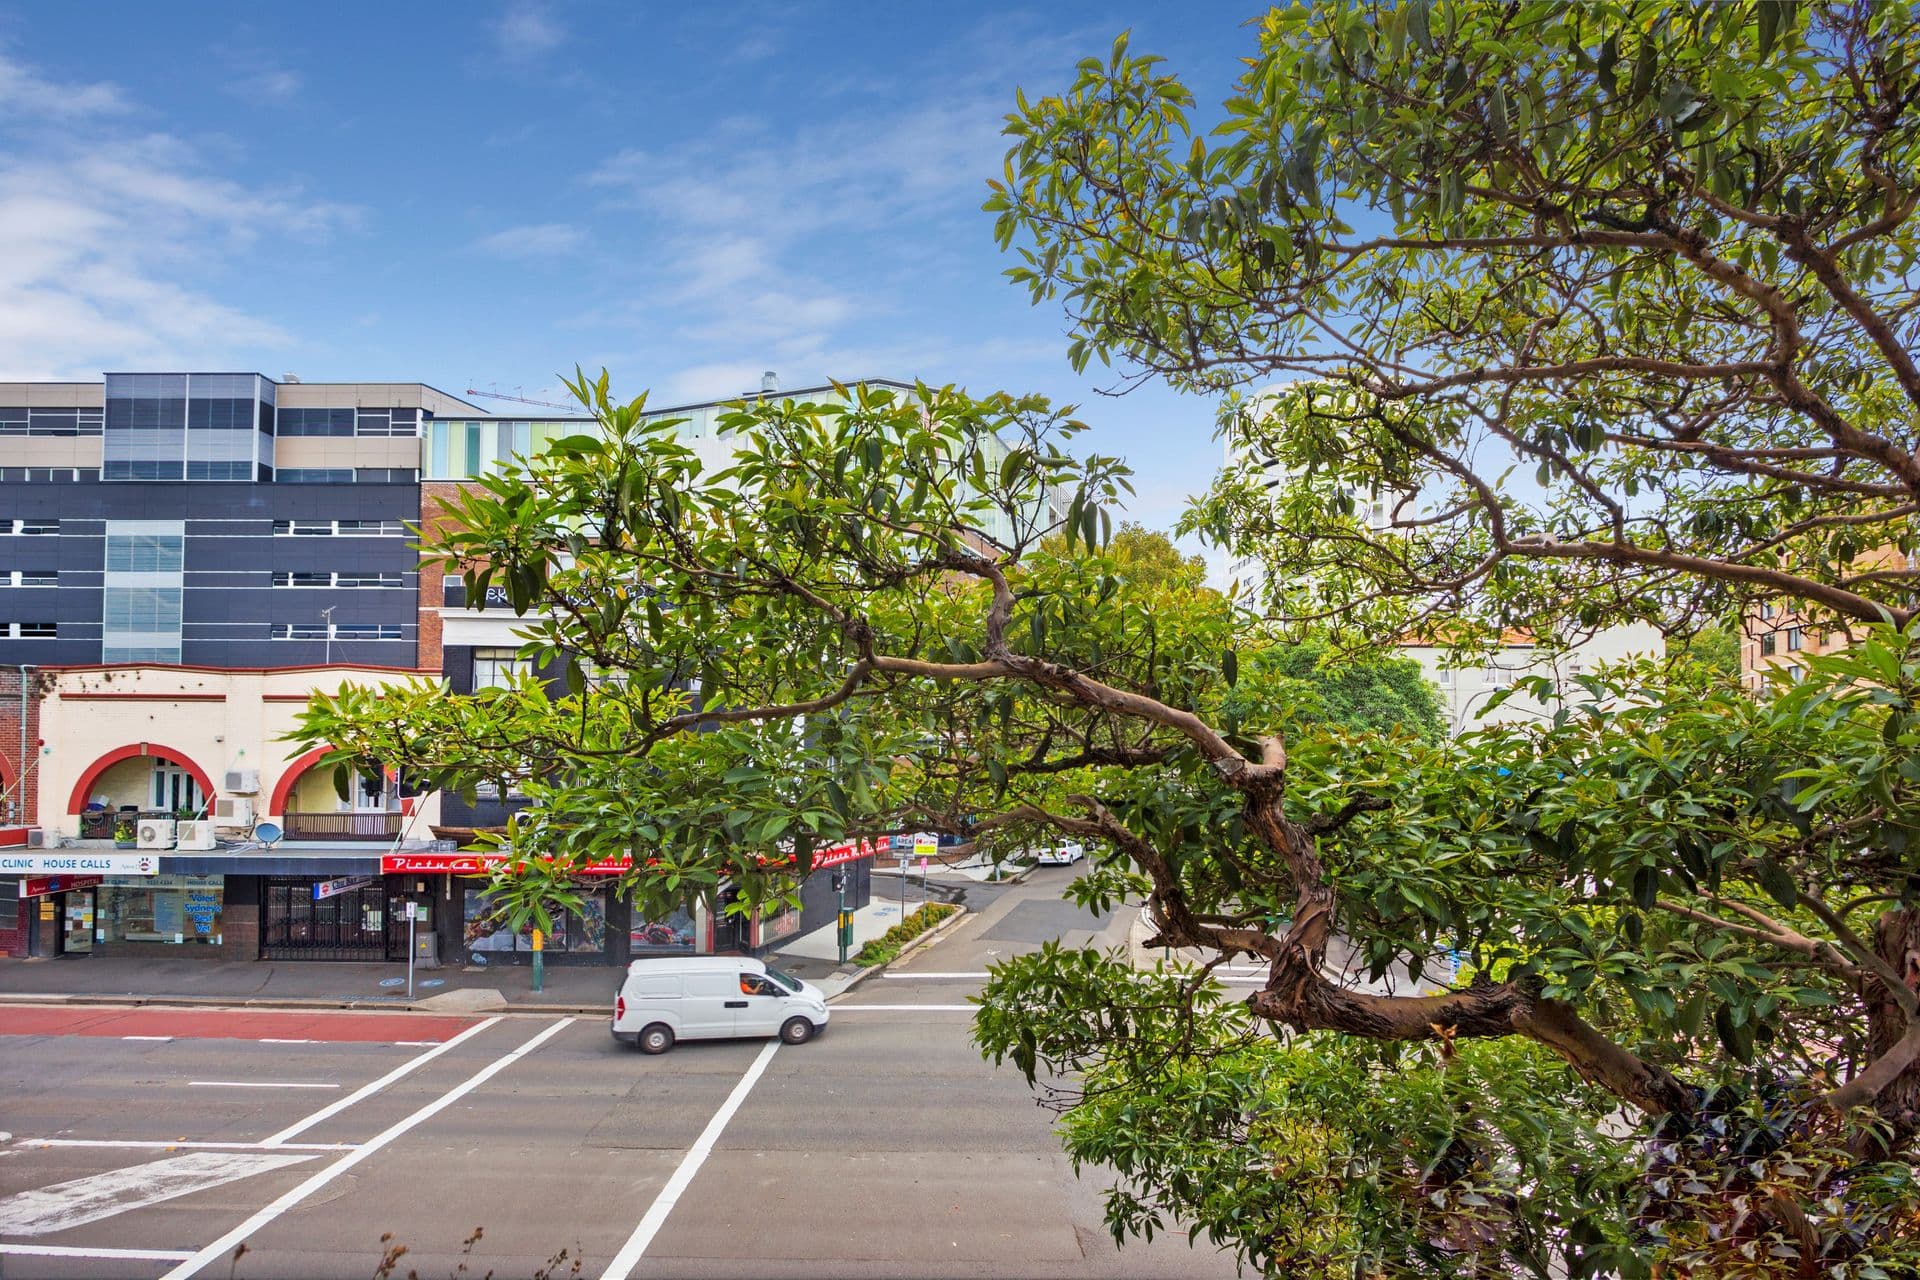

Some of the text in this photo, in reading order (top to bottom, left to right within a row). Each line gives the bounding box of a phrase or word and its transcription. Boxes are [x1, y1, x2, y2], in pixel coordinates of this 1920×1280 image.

[1, 859, 34, 868] CLINIC
[43, 859, 77, 869] HOUSE
[80, 859, 112, 869] CALLS
[393, 857, 475, 870] Picture
[189, 894, 216, 903] Voted
[184, 903, 222, 913] Sydney's
[193, 913, 213, 923] Best
[195, 923, 211, 933] Vet
